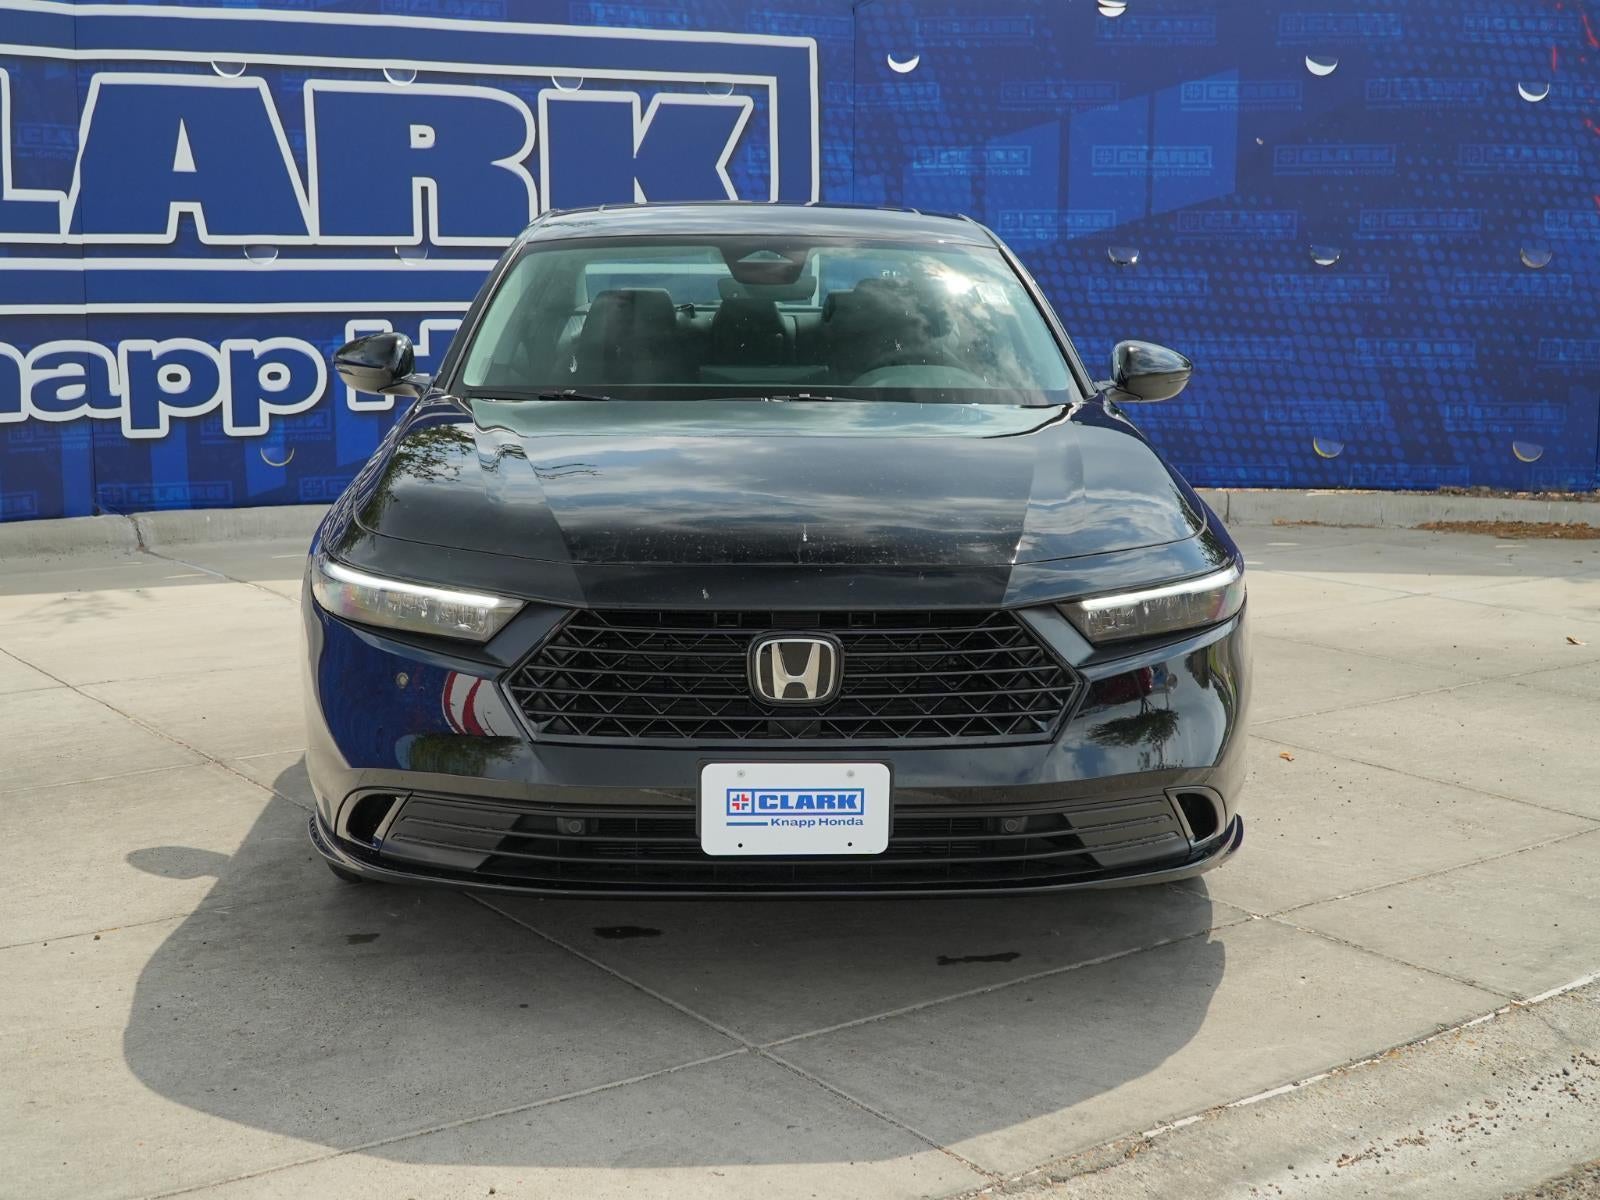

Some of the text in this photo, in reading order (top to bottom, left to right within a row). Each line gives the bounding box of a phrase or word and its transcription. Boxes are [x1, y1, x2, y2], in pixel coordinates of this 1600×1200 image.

[0, 67, 755, 246] ARK
[758, 794, 858, 810] CLARK
[770, 817, 864, 828] Knapp Honda
